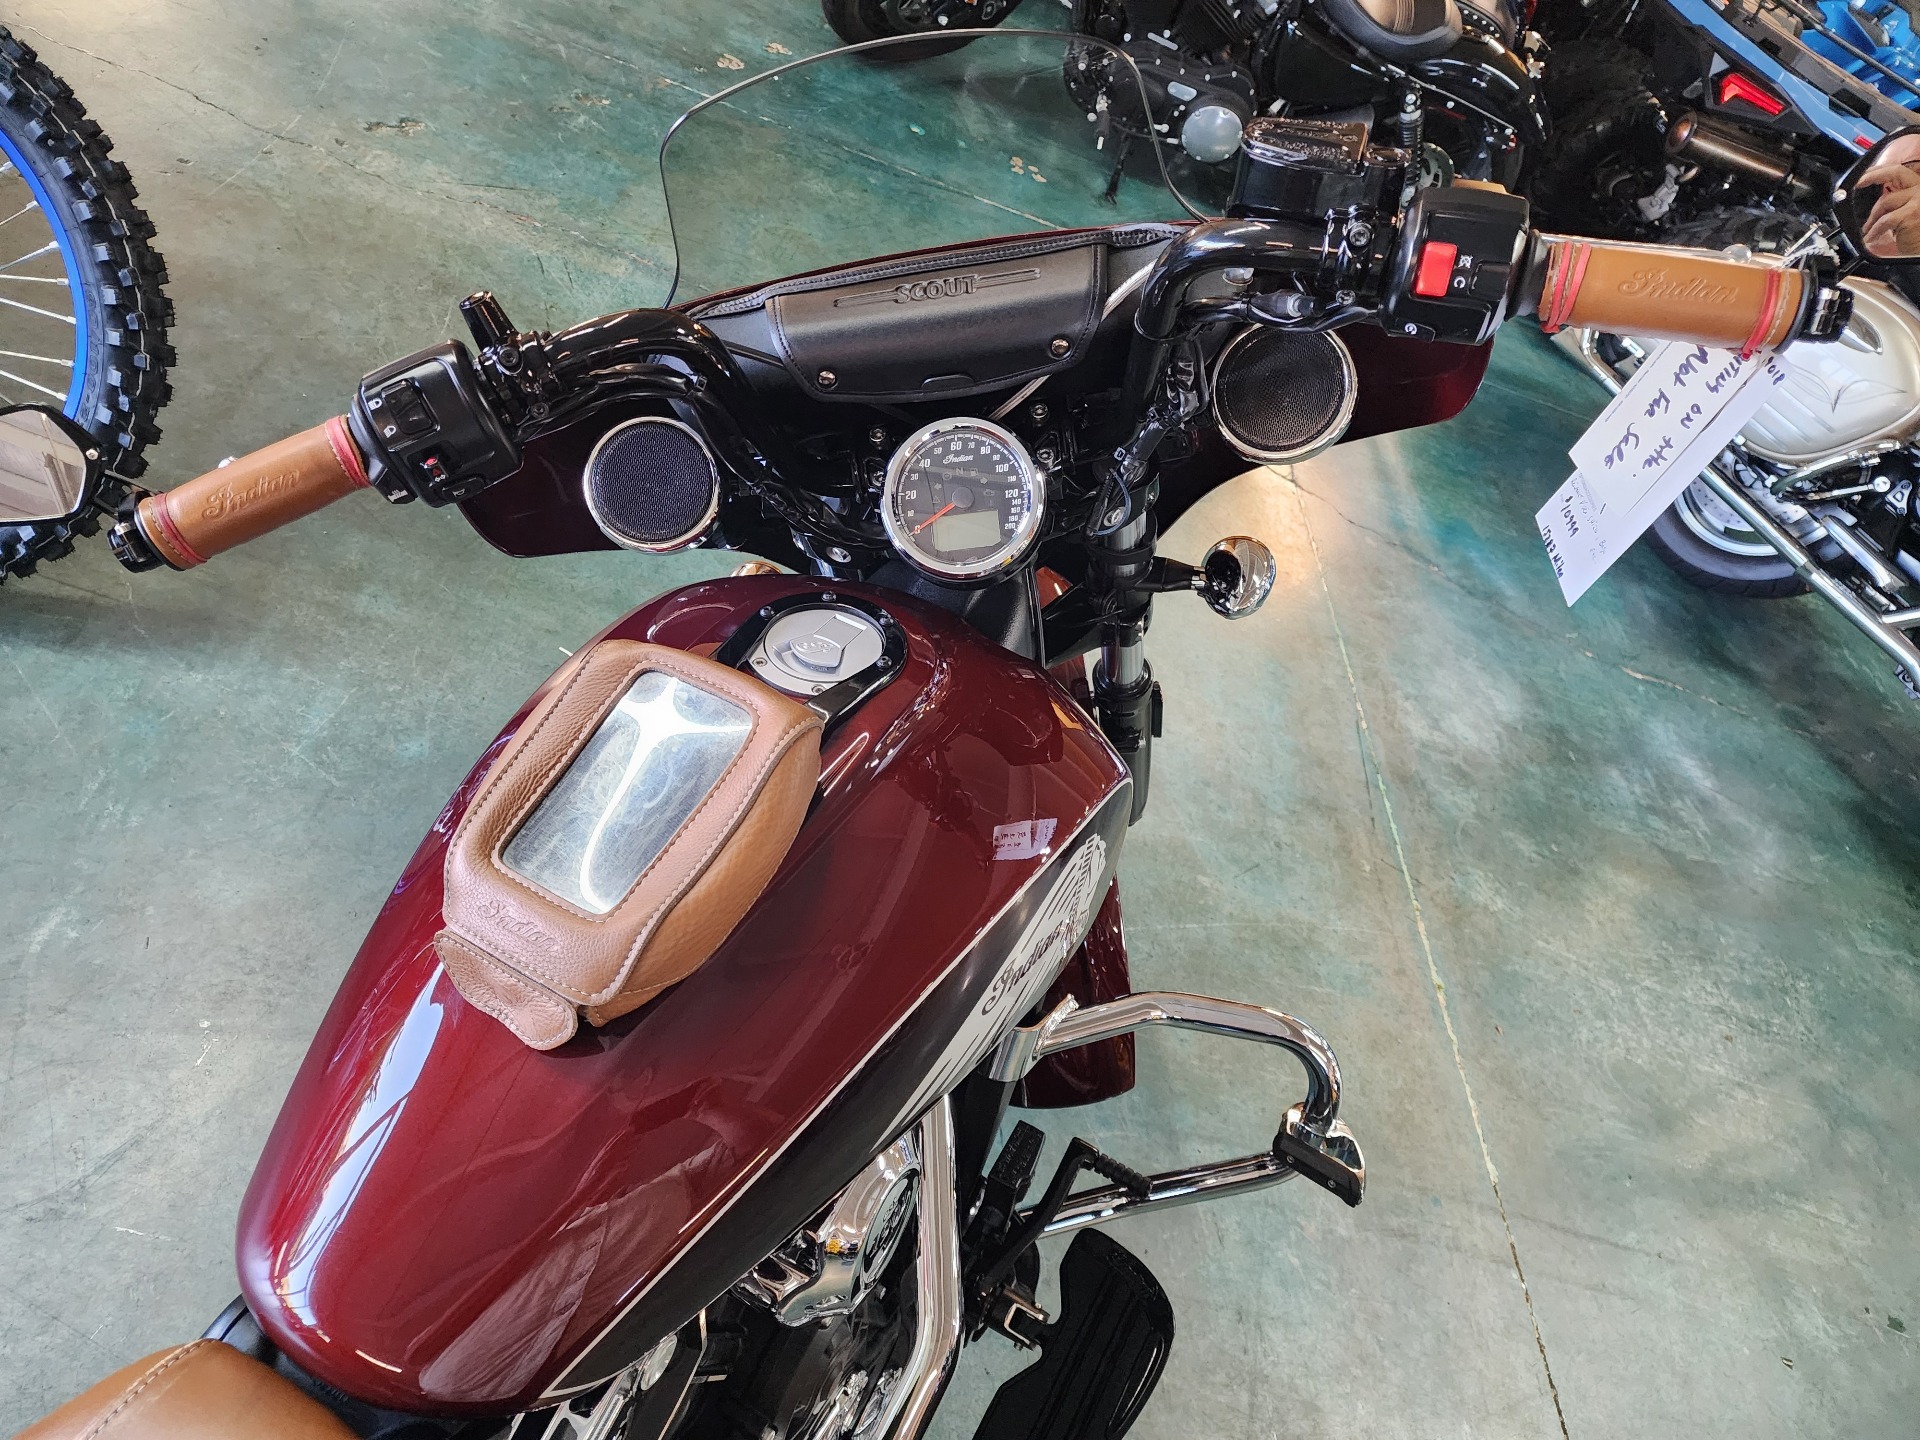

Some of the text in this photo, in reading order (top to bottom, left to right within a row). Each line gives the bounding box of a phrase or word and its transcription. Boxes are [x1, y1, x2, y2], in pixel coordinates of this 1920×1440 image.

[896, 275, 978, 303] SCOUT
[1618, 267, 1739, 303] Indian
[950, 441, 962, 451] 60
[968, 441, 975, 449] 70
[980, 445, 991, 455] 80
[919, 458, 930, 468] 40
[943, 453, 973, 464] Indian
[995, 463, 1009, 473] 100
[910, 473, 919, 481] 30
[202, 469, 300, 520] Indian
[905, 490, 917, 500] 20
[1005, 488, 1019, 498] 120
[907, 509, 915, 517] 10
[981, 919, 1064, 1016] Indian
